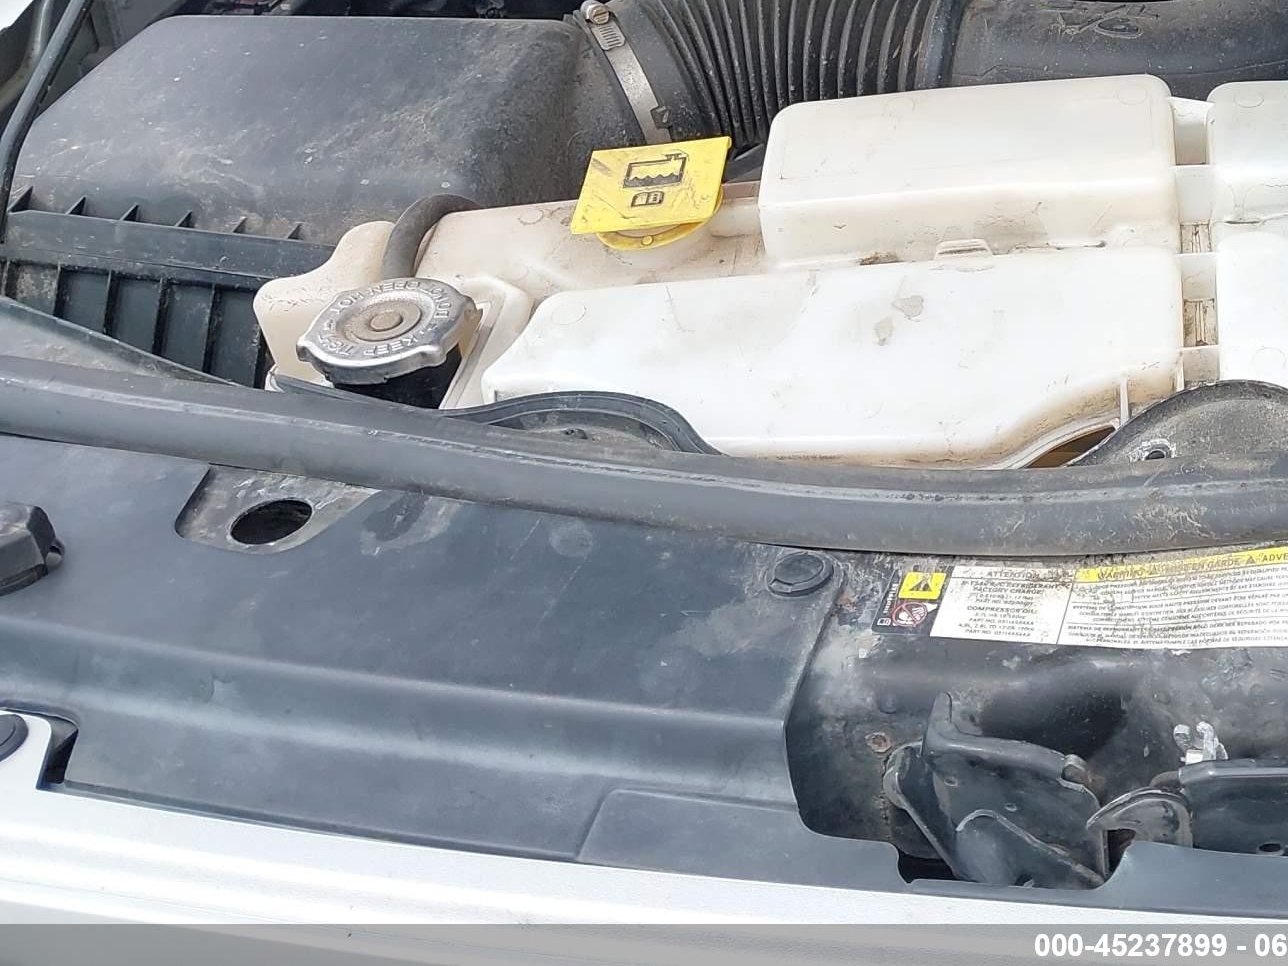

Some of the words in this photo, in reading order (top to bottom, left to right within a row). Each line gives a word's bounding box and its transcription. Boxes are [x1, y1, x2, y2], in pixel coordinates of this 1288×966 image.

[368, 281, 420, 296] OPEN
[329, 292, 364, 314] HOT
[363, 335, 418, 356] KEEP
[967, 605, 1021, 613] COMPRESSOR
